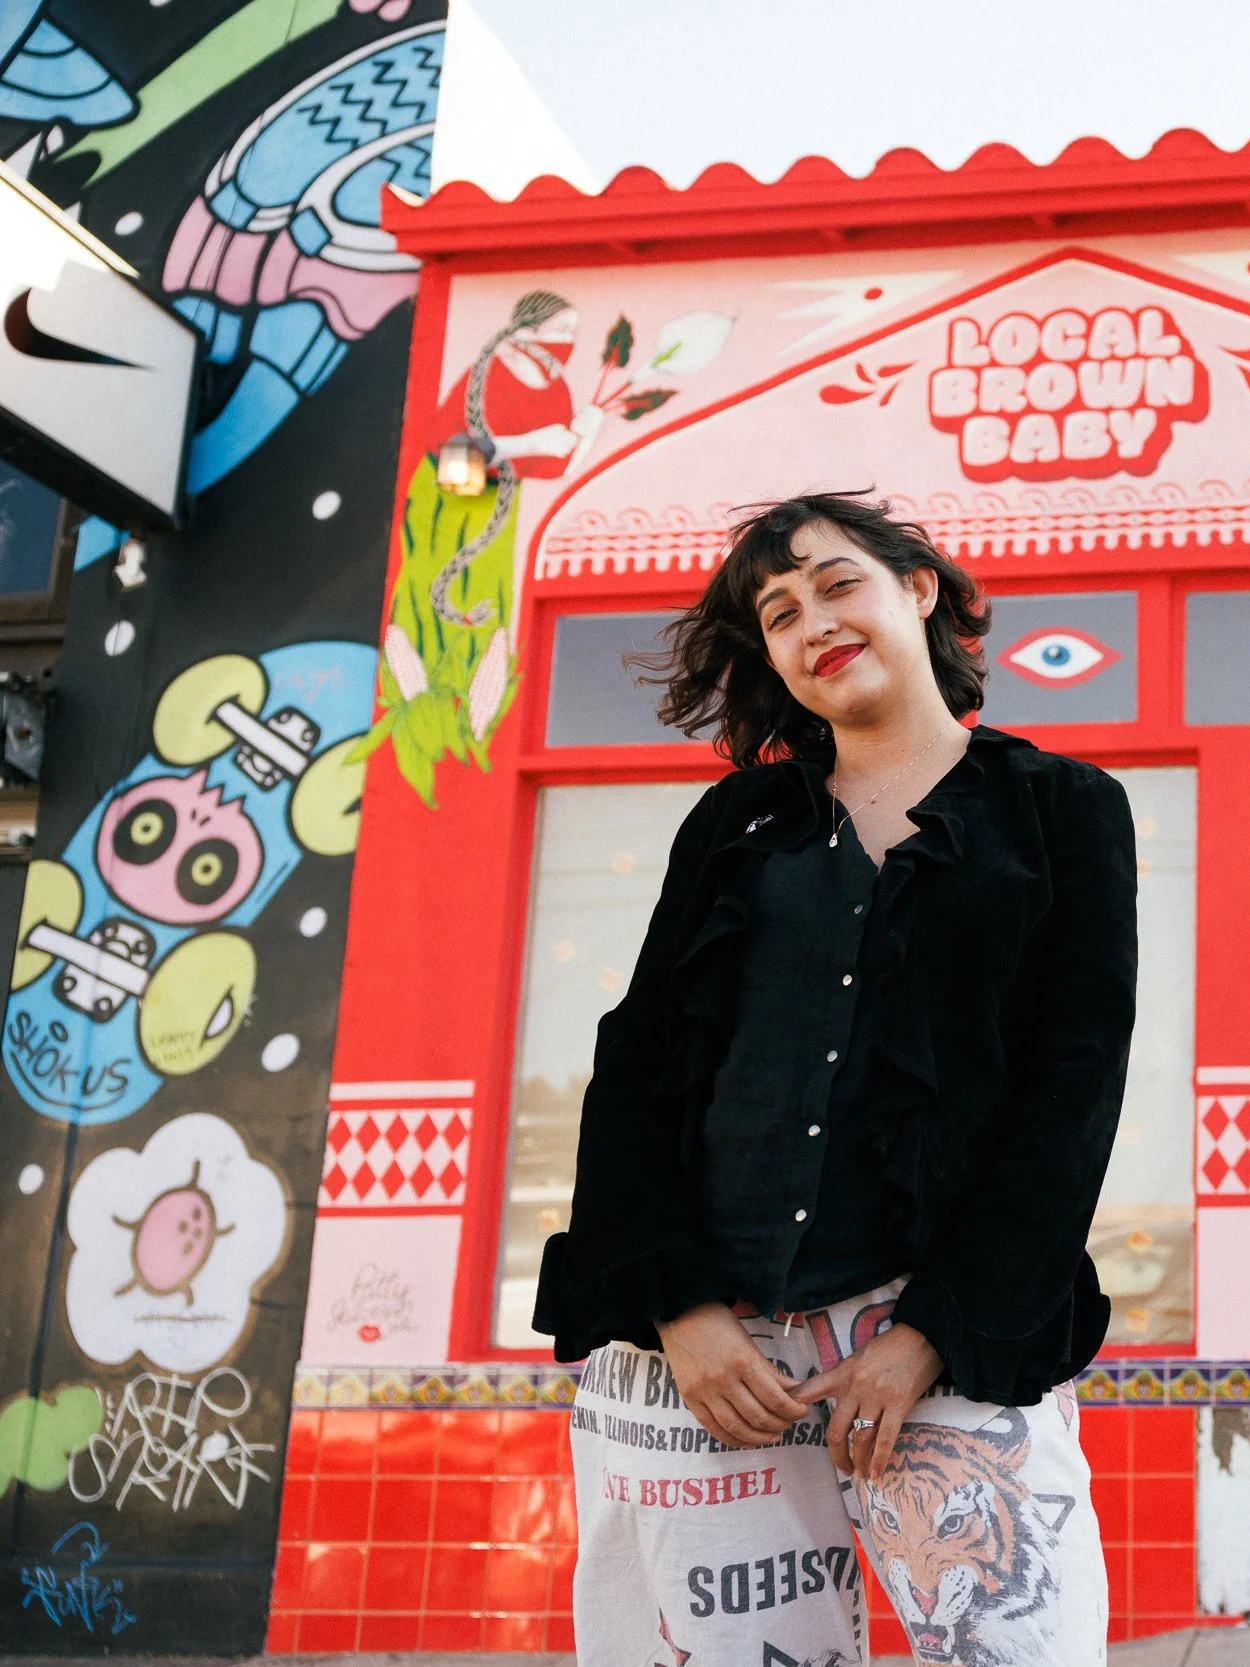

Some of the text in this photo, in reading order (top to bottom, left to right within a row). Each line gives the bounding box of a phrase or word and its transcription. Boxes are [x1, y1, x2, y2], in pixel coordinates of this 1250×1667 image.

[949, 306, 1183, 368] LOCAL
[930, 355, 1197, 419] BROWN
[961, 407, 1159, 468] BABY
[638, 1466, 782, 1509] BUSHEL
[687, 1548, 826, 1618] SEEDS
